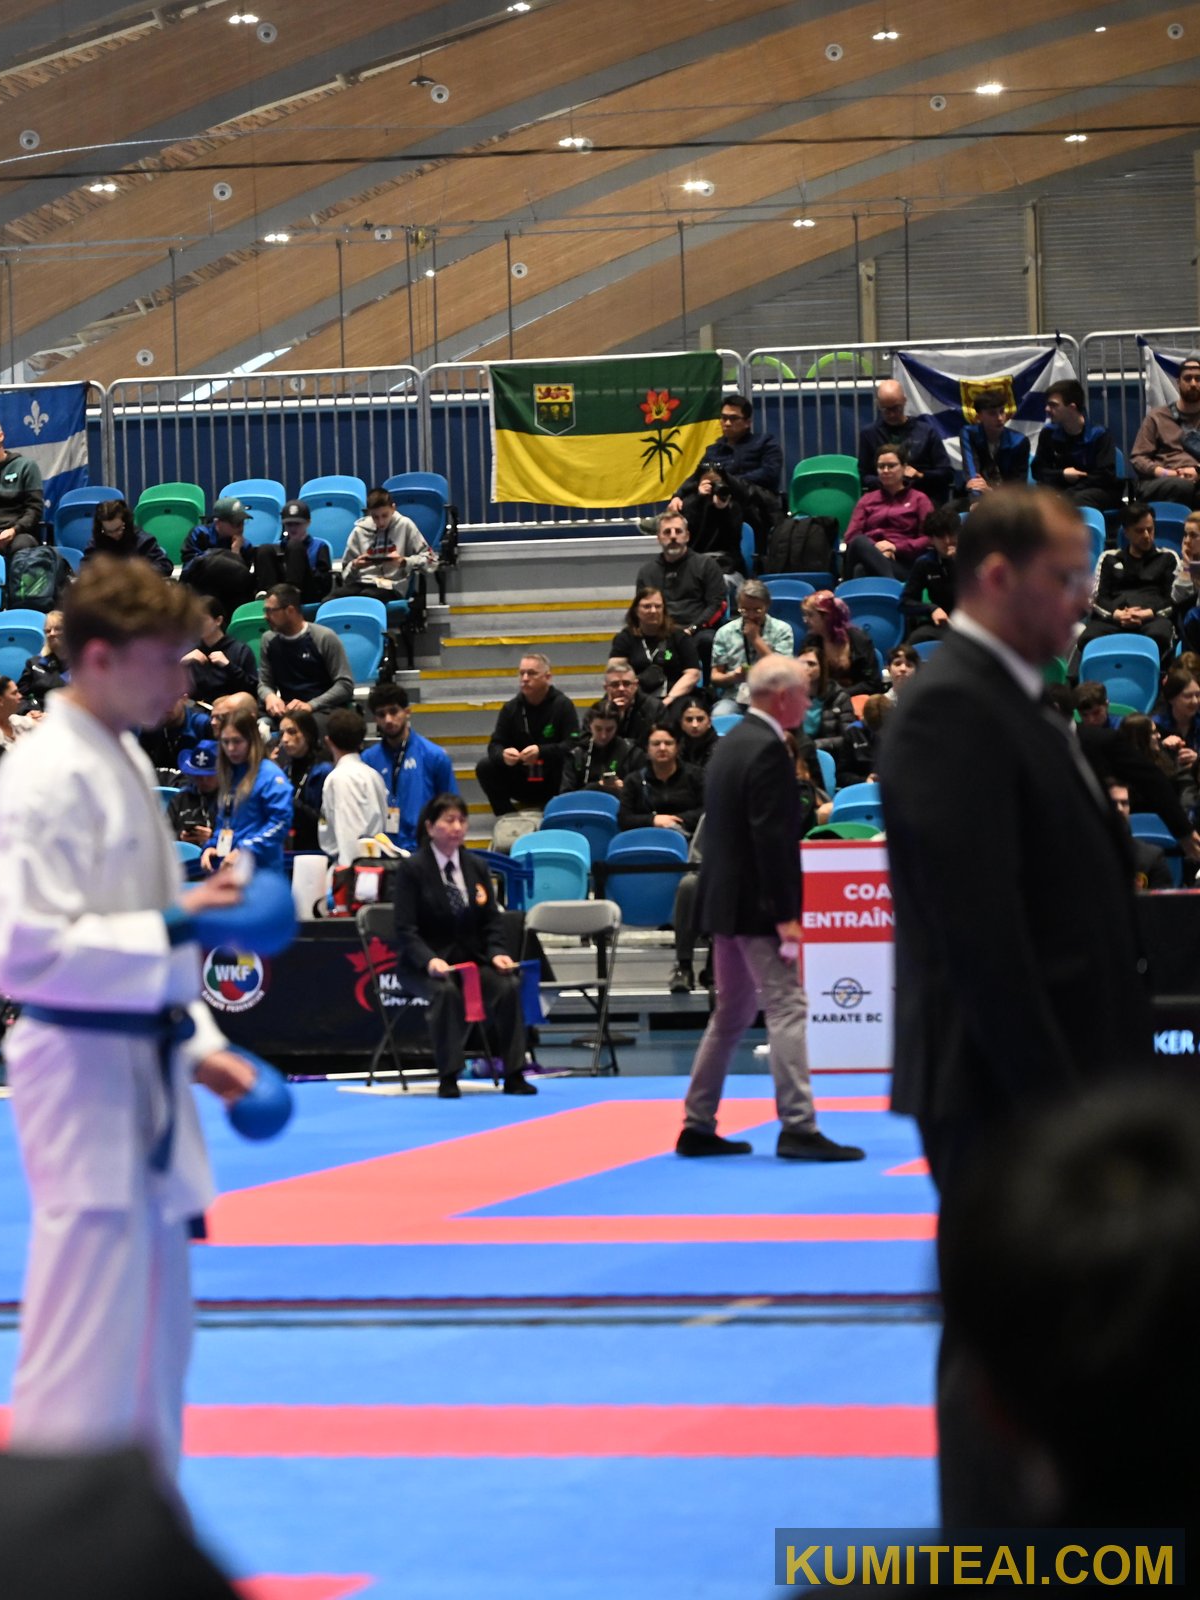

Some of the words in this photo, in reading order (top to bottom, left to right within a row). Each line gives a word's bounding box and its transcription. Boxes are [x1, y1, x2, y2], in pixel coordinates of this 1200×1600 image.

[843, 883, 893, 900] COA
[802, 906, 896, 928] ENTRAÎN
[214, 964, 251, 982] WKF
[812, 1013, 861, 1023] KARATE
[865, 1013, 882, 1022] BC
[1153, 1029, 1196, 1055] KER
